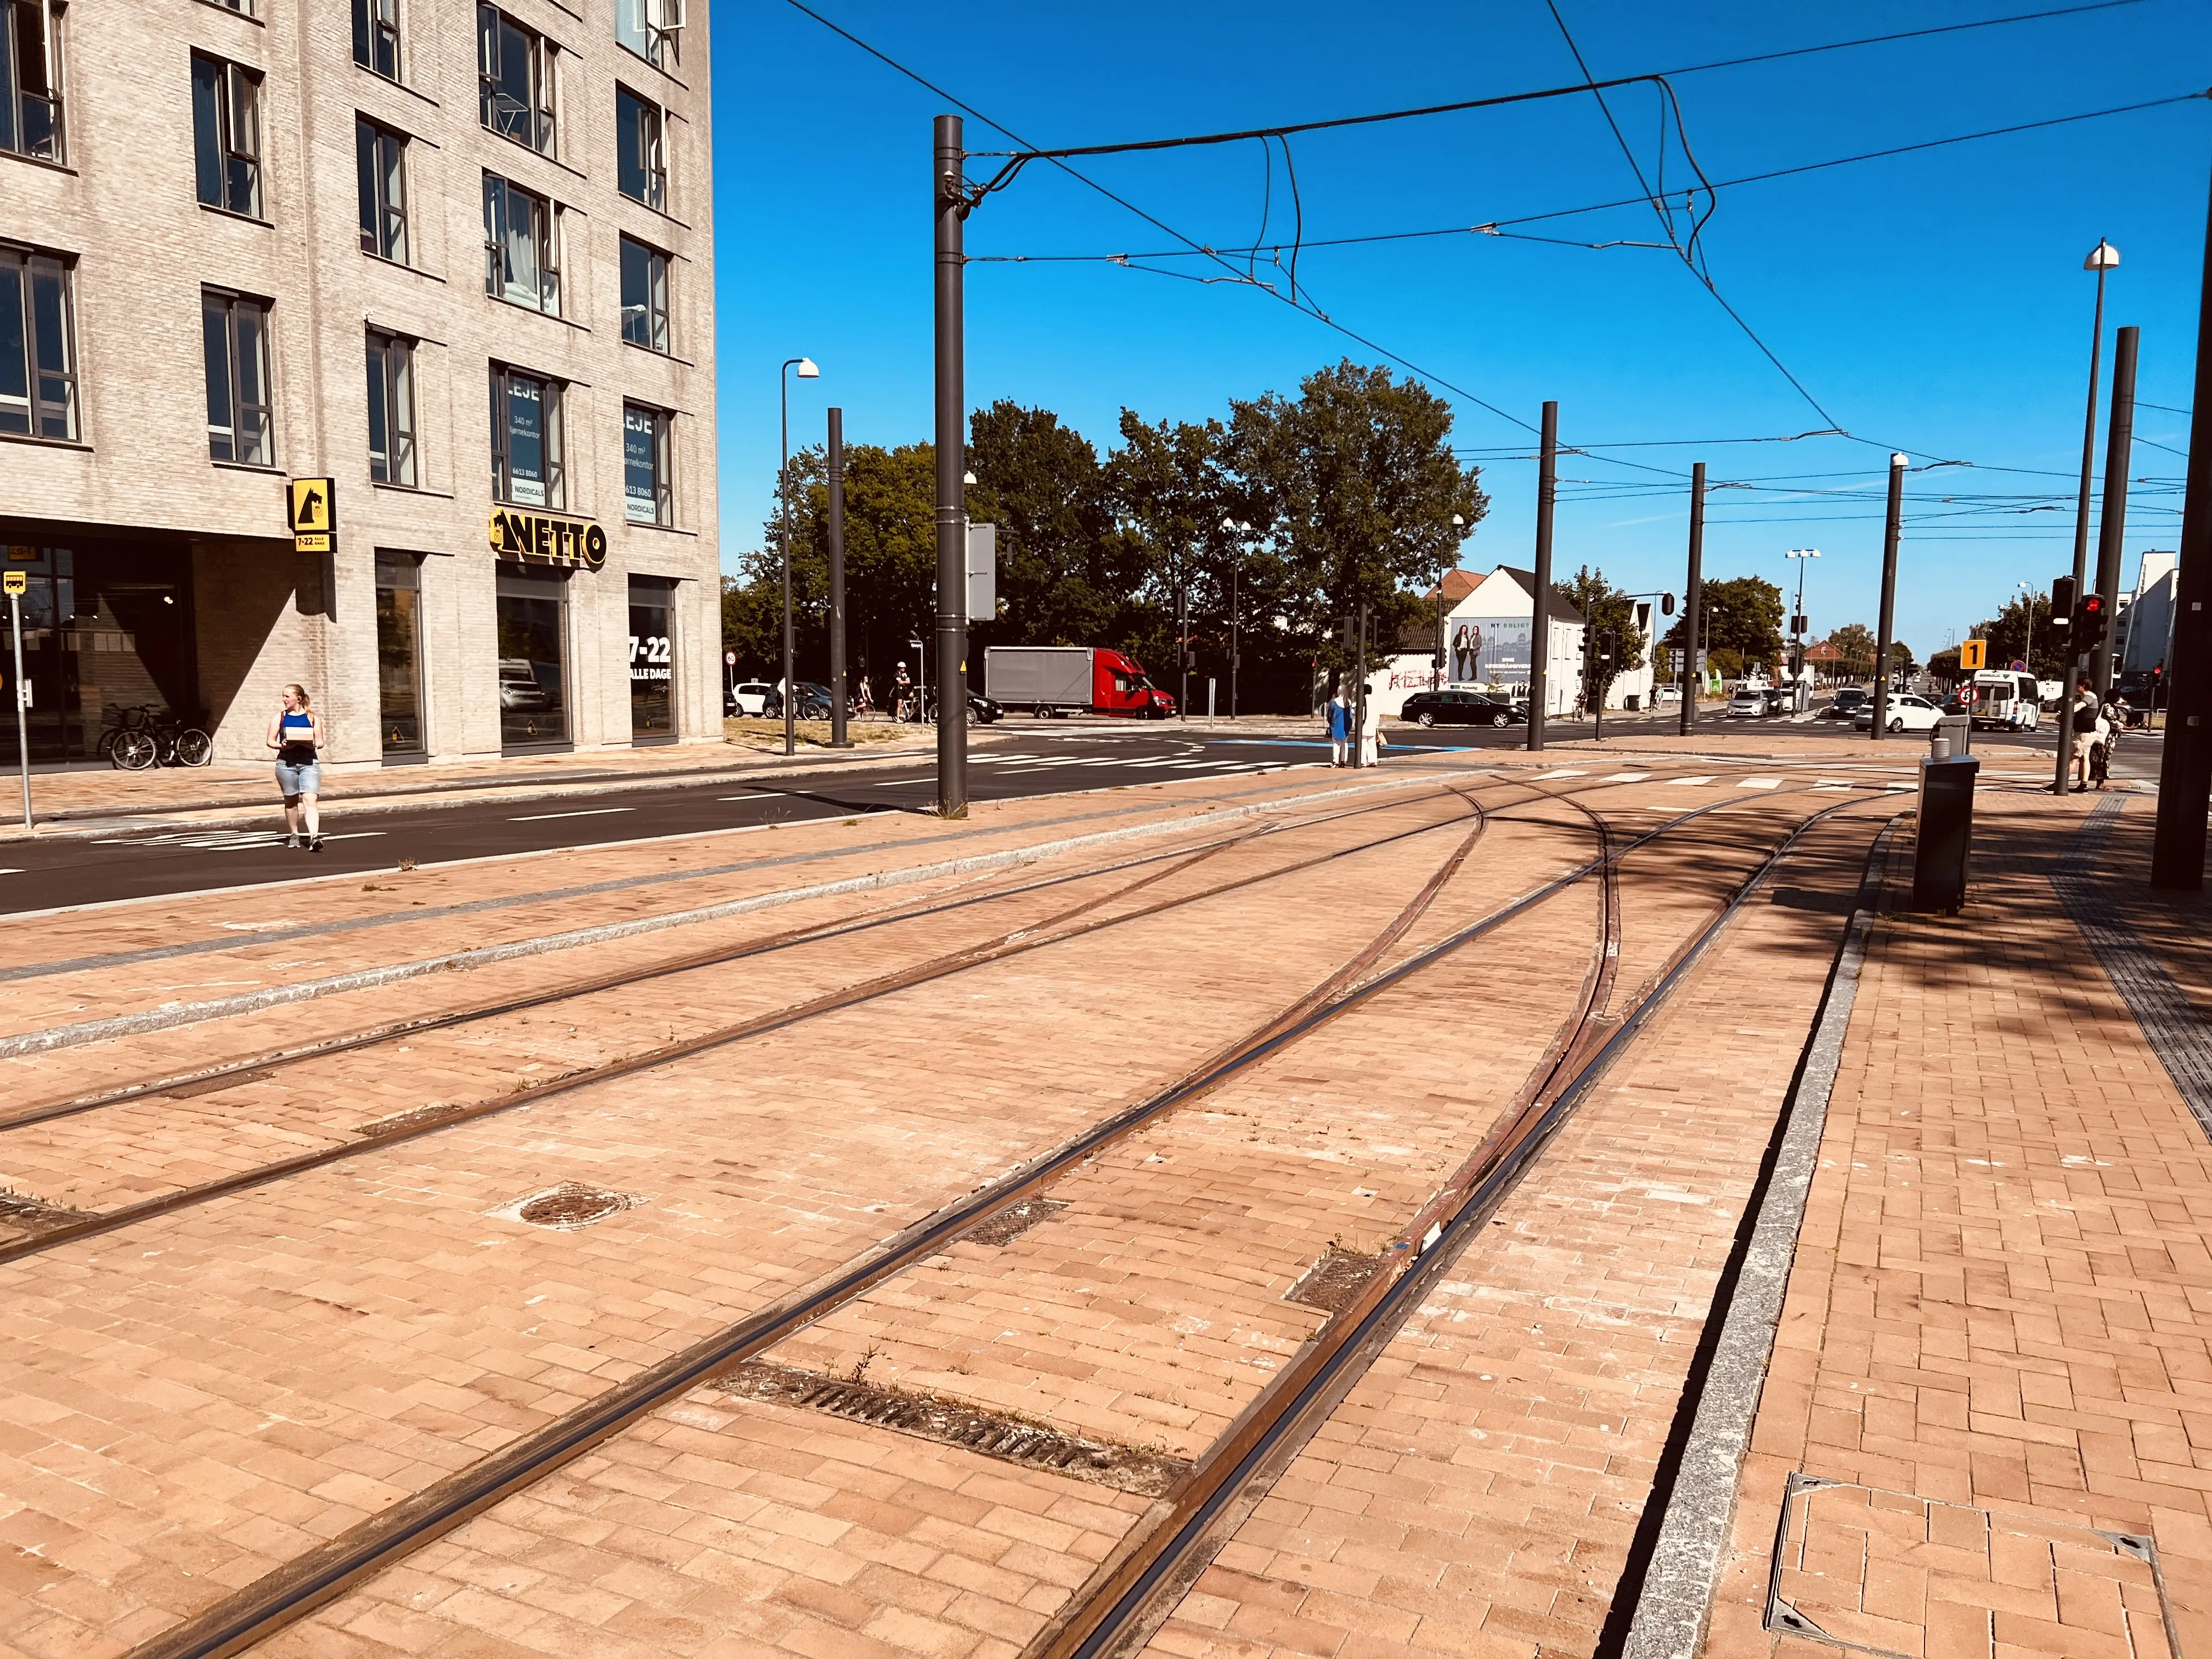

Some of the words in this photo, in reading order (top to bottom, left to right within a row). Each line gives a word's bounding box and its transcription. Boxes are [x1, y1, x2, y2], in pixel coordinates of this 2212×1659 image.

[514, 415, 525, 426] 340
[626, 443, 637, 454] 340
[638, 447, 646, 455] m²
[512, 467, 525, 476] 6613
[515, 486, 544, 497] NORDICALS
[637, 487, 652, 498] 8060
[627, 504, 654, 514] NORDICALS
[298, 537, 313, 546] 7-22
[492, 509, 607, 564] NETTO
[629, 636, 671, 663] 7-22
[1969, 644, 1978, 665] 1
[630, 668, 649, 680] ALLE
[650, 668, 672, 680] DAGE
